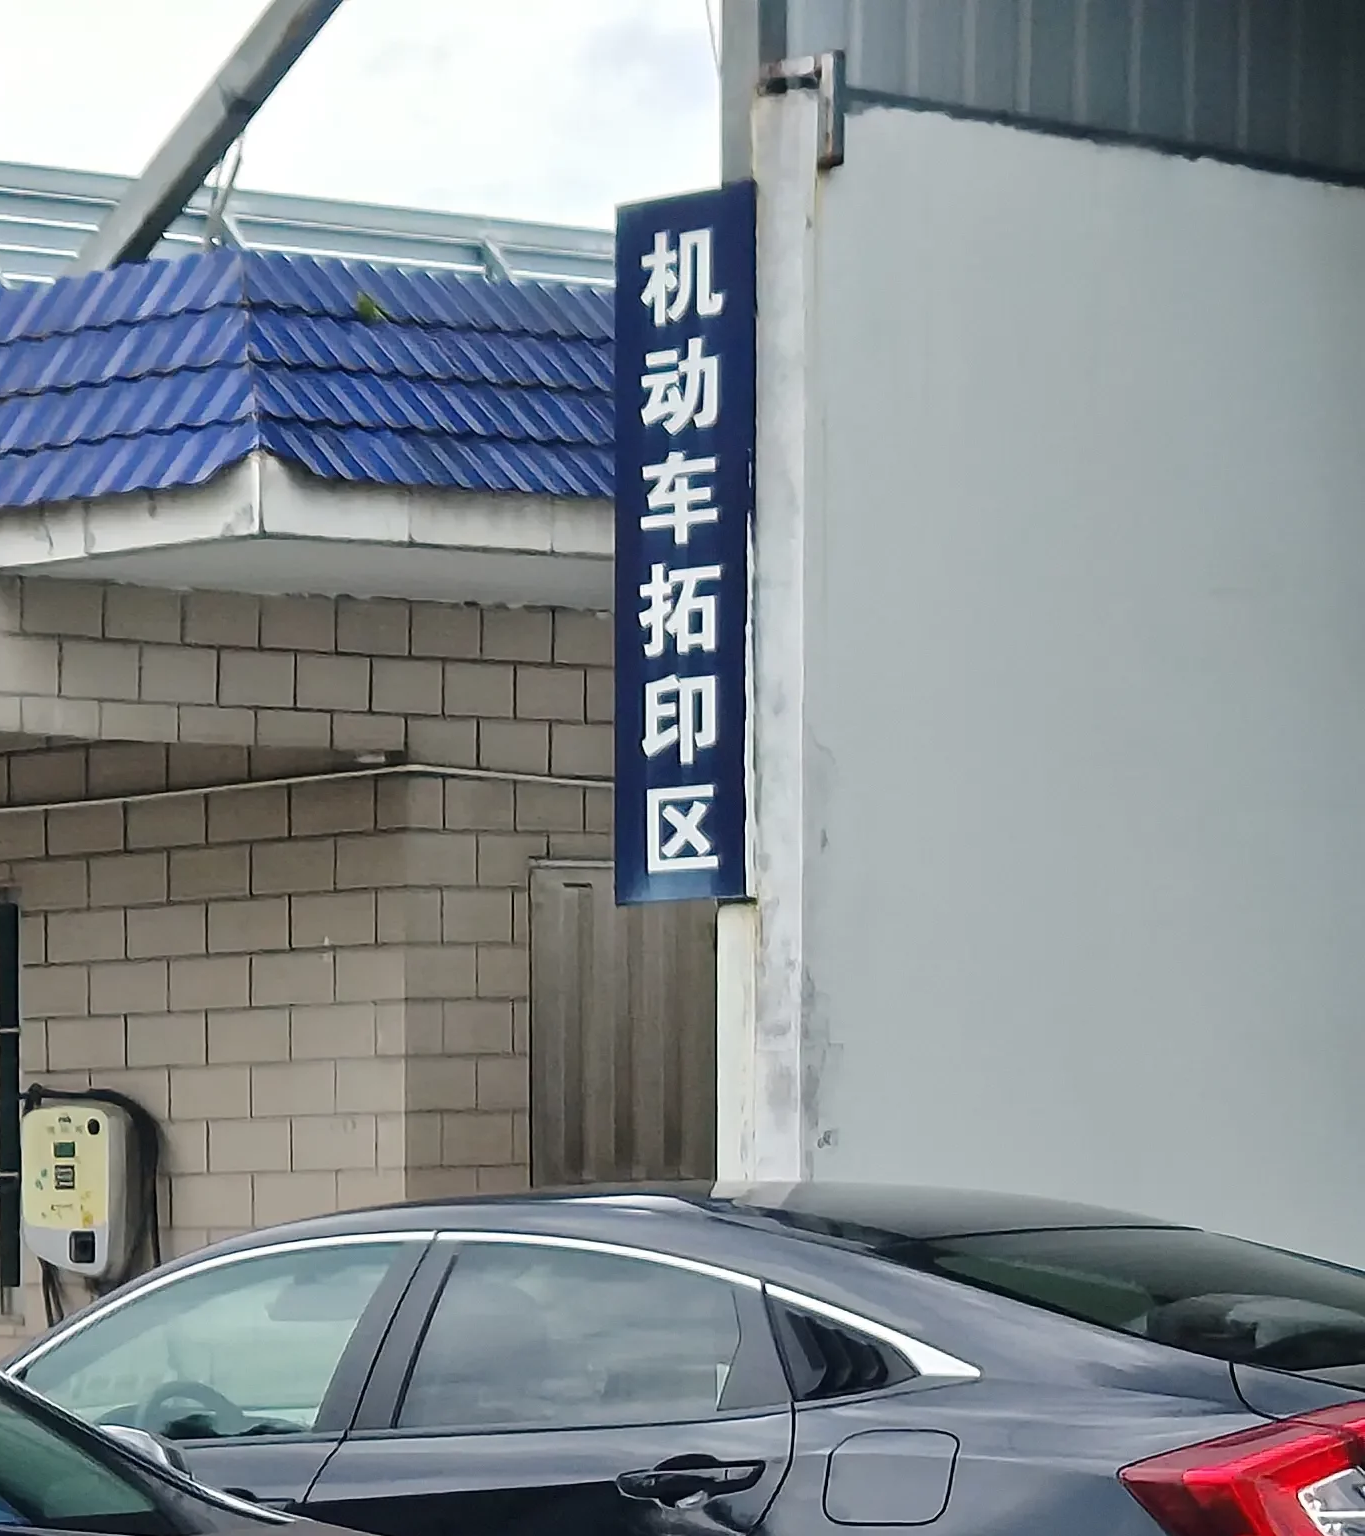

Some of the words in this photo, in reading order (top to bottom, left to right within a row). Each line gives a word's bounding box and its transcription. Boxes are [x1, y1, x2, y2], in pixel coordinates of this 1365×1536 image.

[638, 228, 724, 875] 机动车拓印区
